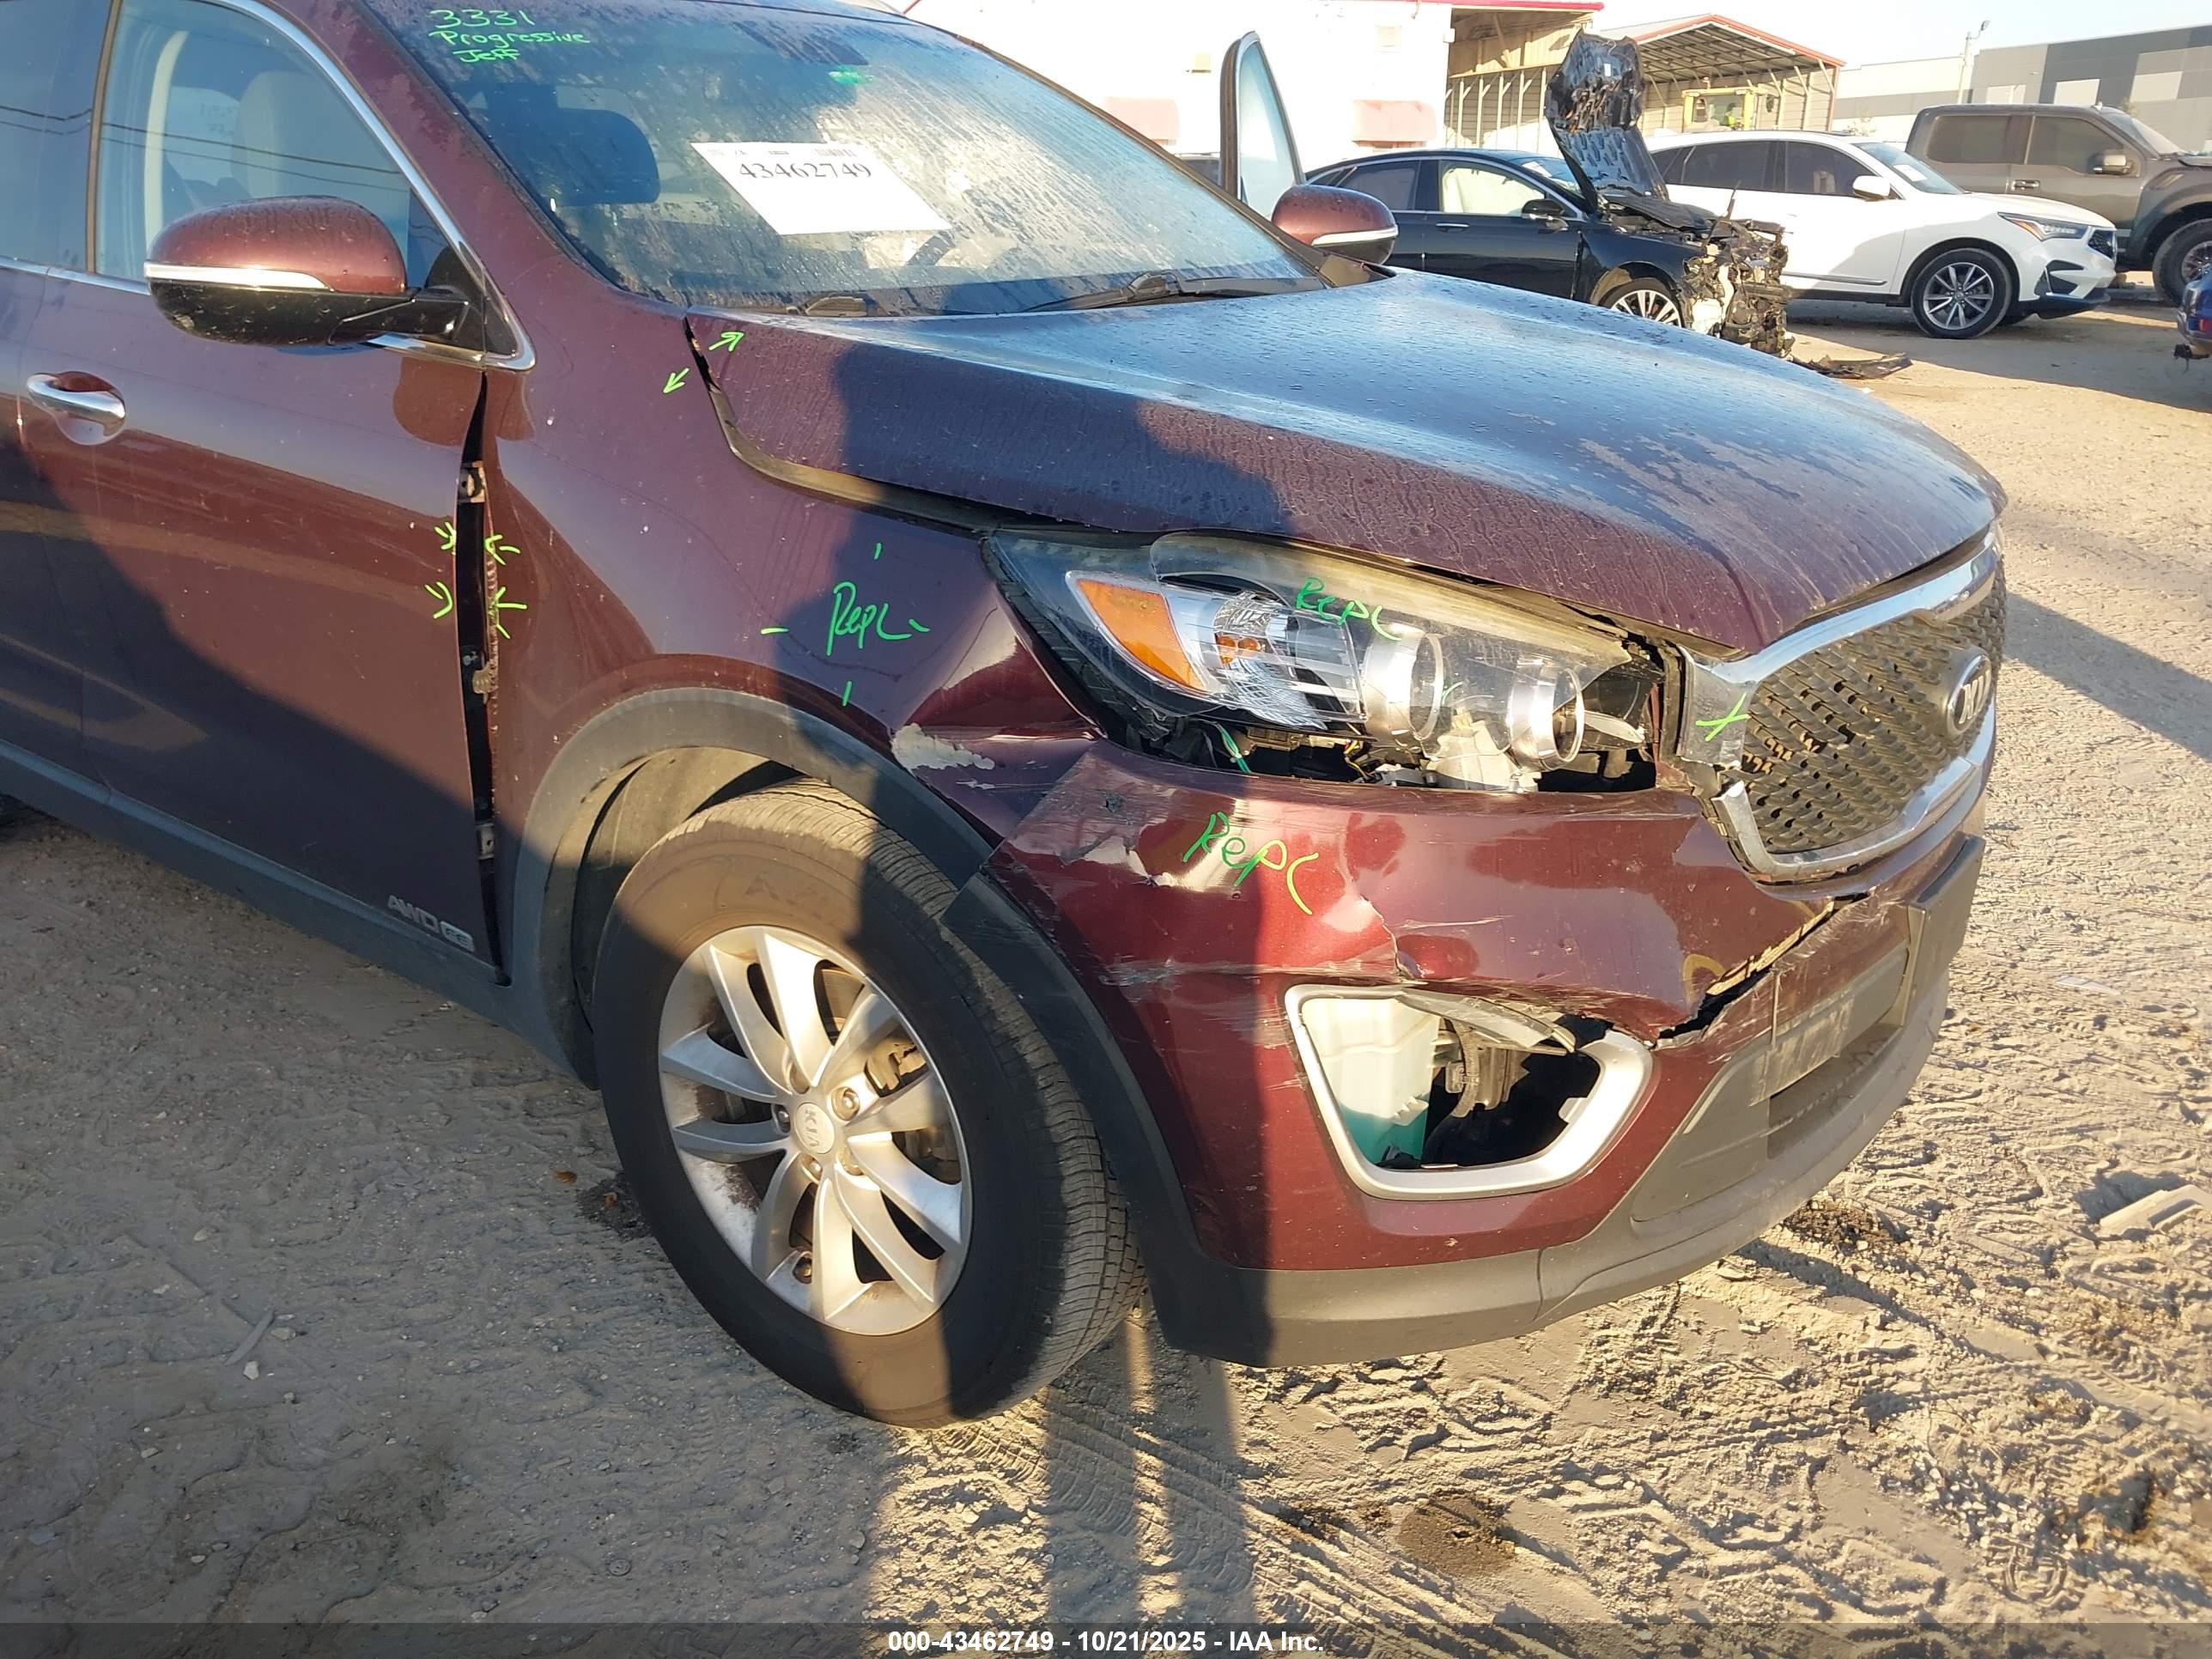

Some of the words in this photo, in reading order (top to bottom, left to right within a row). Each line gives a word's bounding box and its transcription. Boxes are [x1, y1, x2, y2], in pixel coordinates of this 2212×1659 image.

[429, 9, 536, 28] 3331
[428, 30, 591, 49] Progressive
[453, 49, 520, 63] Jeff
[739, 163, 872, 179] 43462749
